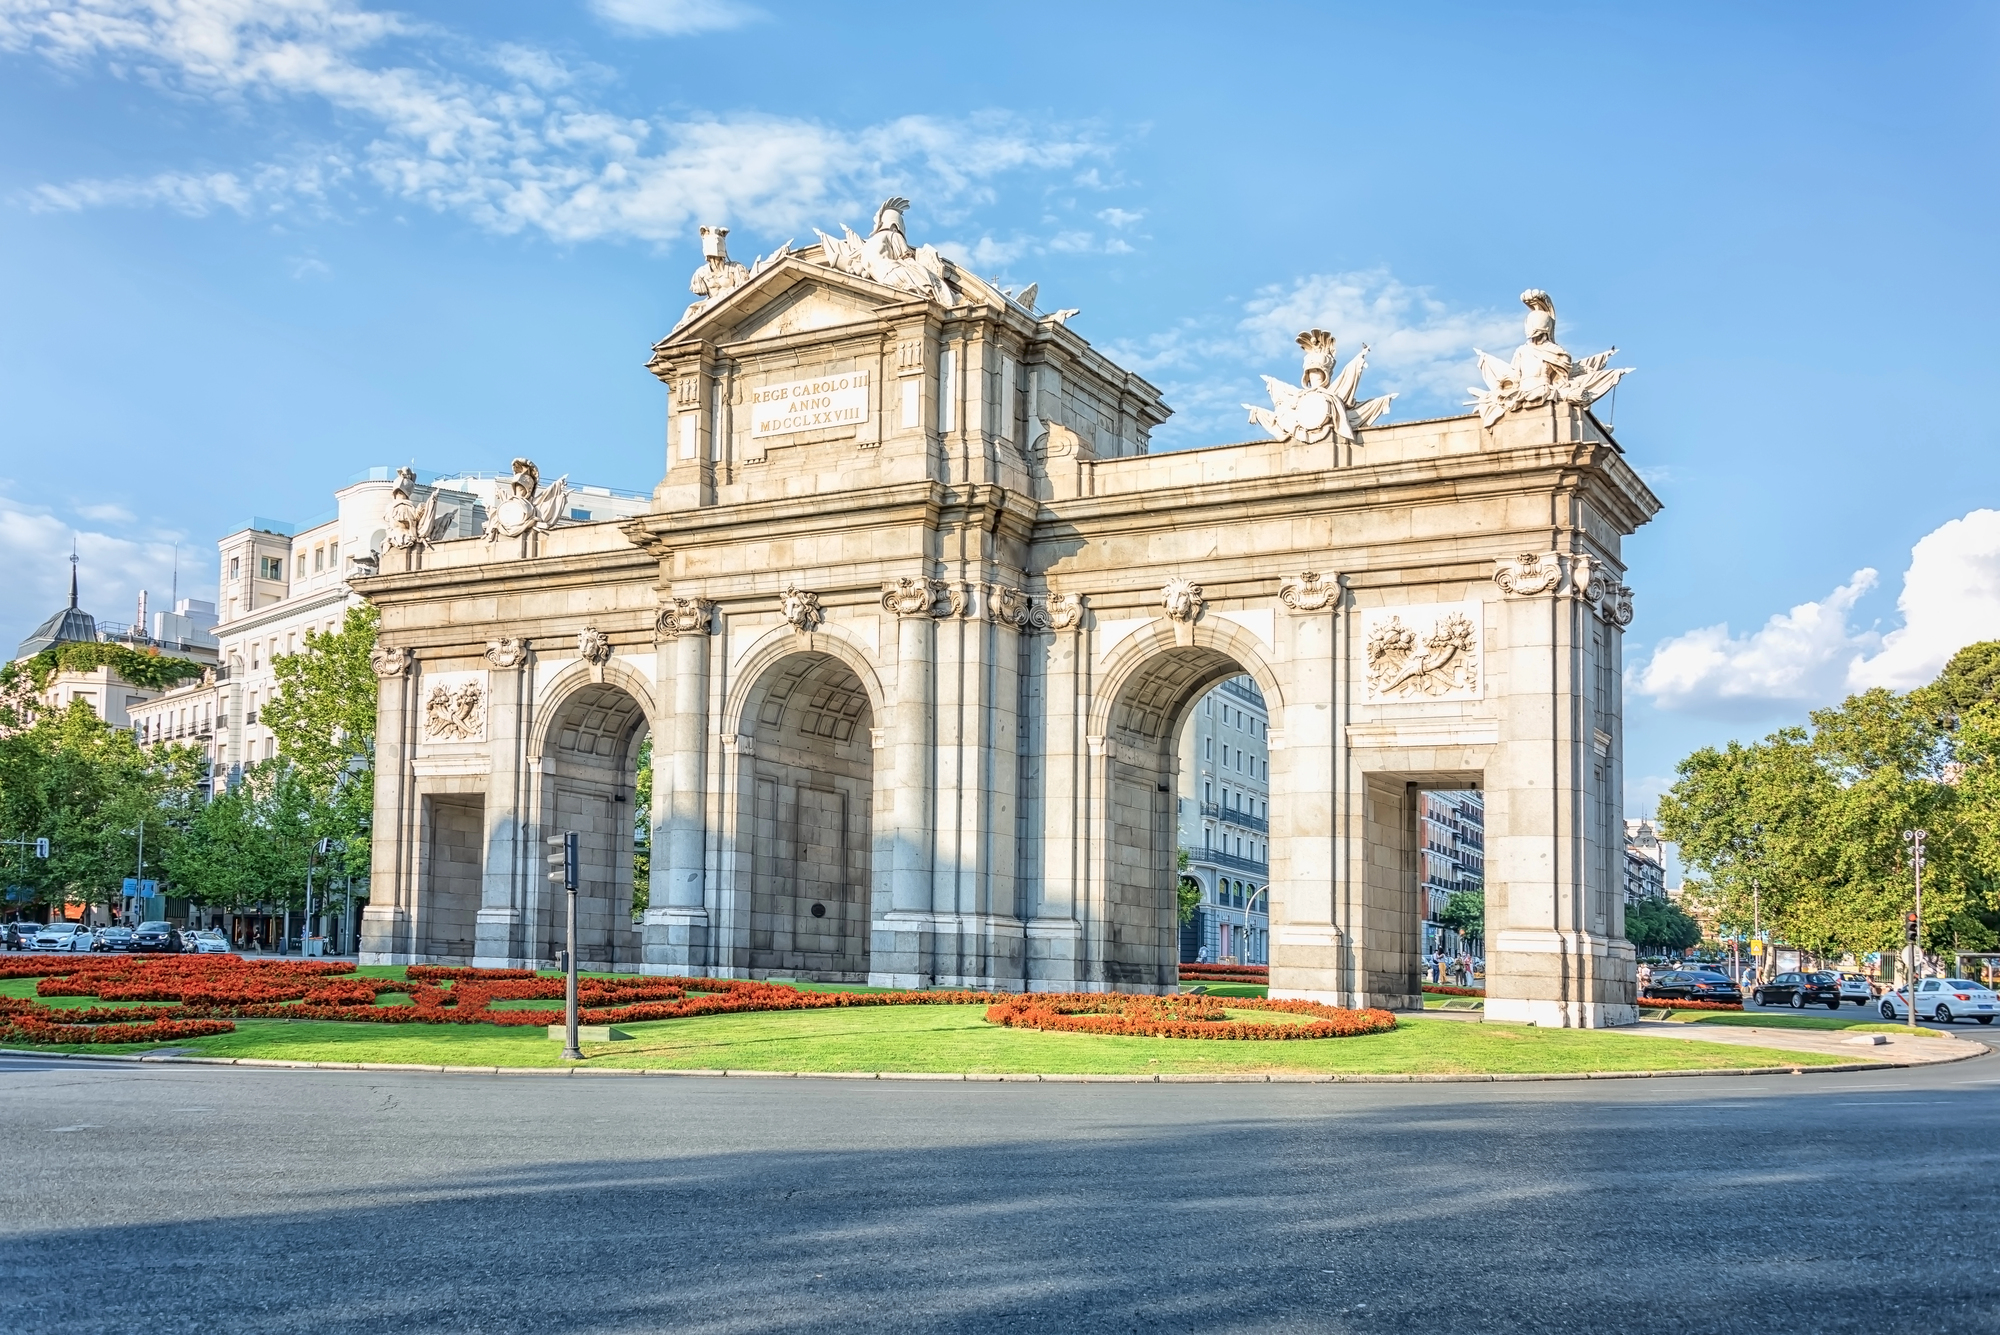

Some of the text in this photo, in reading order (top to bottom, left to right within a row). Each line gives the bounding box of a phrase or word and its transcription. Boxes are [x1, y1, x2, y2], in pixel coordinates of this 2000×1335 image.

[753, 375, 869, 404] REGE CAROLO III
[788, 396, 831, 413] ANNO
[760, 407, 860, 432] MDCCLXXVIII
